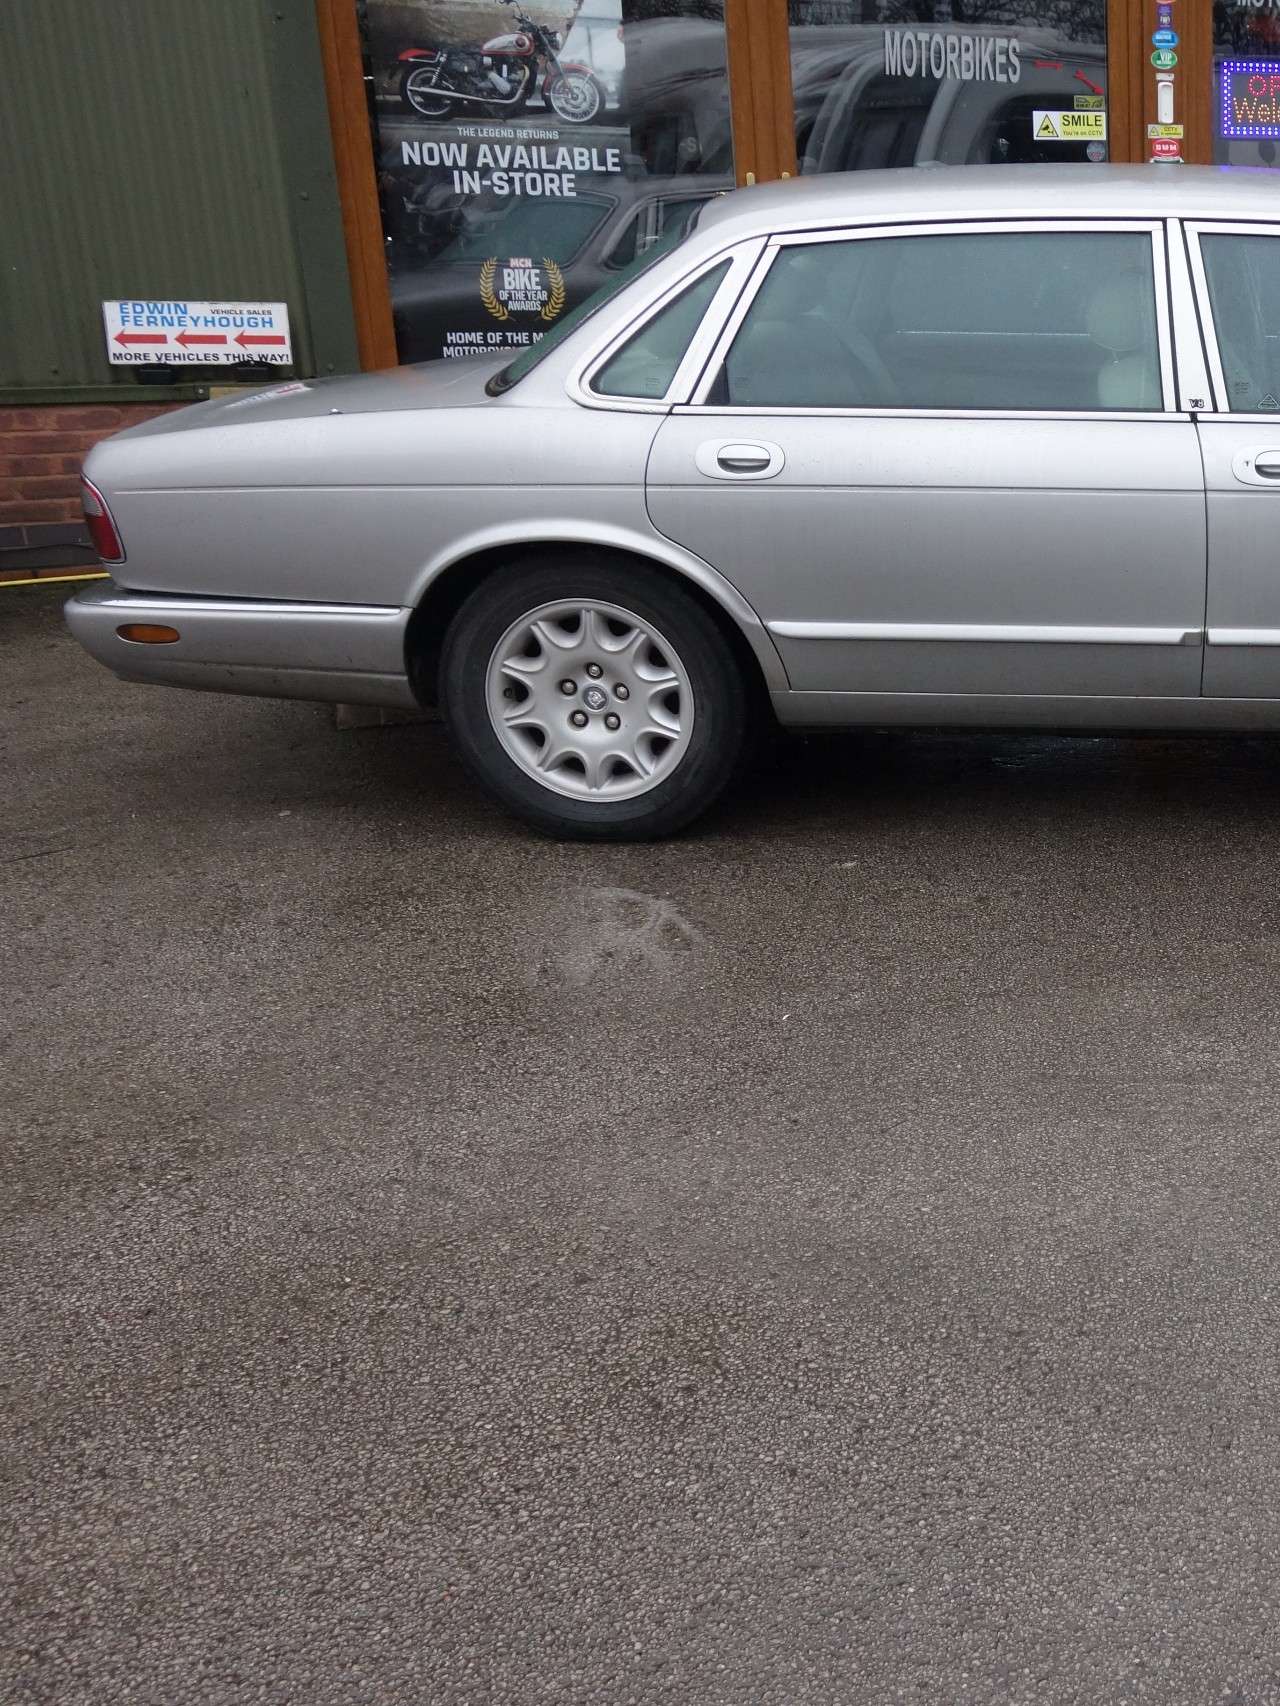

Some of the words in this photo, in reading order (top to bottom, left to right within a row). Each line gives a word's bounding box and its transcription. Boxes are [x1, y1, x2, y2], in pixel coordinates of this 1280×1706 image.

[884, 30, 1021, 83] MOTORBIKES
[1062, 114, 1103, 127] SMILE
[457, 127, 475, 136] THE
[478, 128, 514, 138] LEGEND
[516, 129, 559, 140] RETURNS
[401, 141, 467, 167] NOW
[477, 144, 621, 172] AVAILABLE
[453, 170, 577, 197] IN-STORE
[510, 258, 532, 268] MCN
[503, 269, 541, 290] BIKE
[499, 290, 510, 301] OF
[511, 290, 526, 301] THE
[526, 290, 548, 301] YEAR
[119, 303, 188, 315] EDWIN
[508, 301, 542, 311] AWARDS
[121, 315, 274, 328] FERNEYHOUGH
[447, 332, 484, 344] HOME
[487, 332, 503, 344] OF
[505, 332, 529, 344] THE
[112, 352, 151, 361] MORE
[155, 352, 220, 362] VEHICLES
[224, 353, 254, 362] THIS
[257, 353, 290, 362] WAY!
